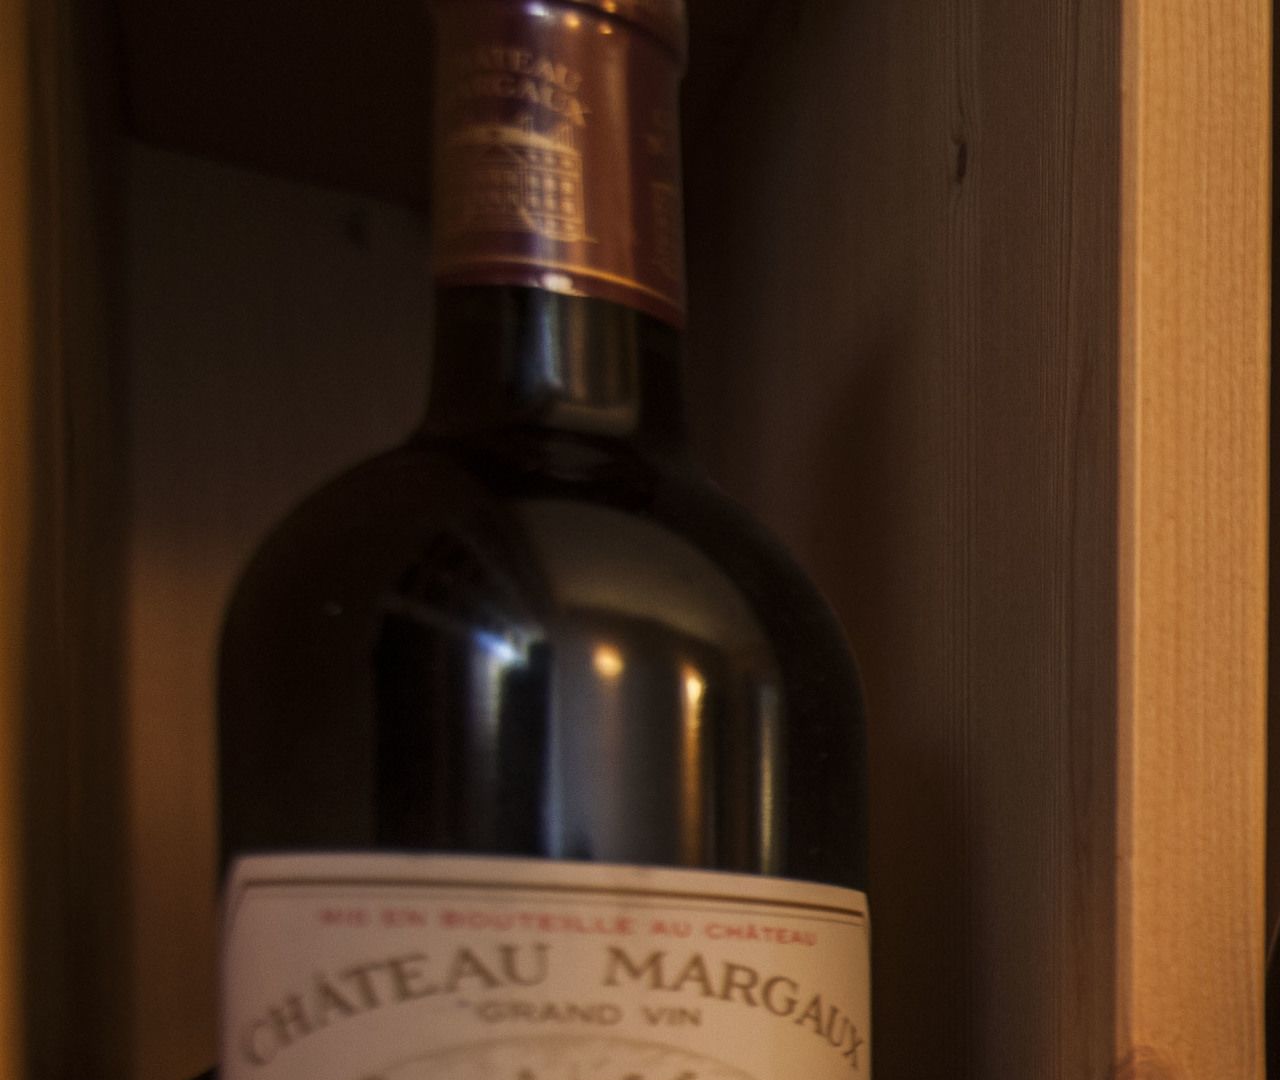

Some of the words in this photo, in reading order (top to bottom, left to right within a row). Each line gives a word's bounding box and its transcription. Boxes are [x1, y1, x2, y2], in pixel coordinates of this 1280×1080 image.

[440, 910, 632, 937] BOUTEILLE
[652, 920, 693, 938] AU
[475, 1000, 624, 1027] GRAND
[642, 1006, 703, 1027] VIN
[602, 946, 865, 1072] MARGAUX
